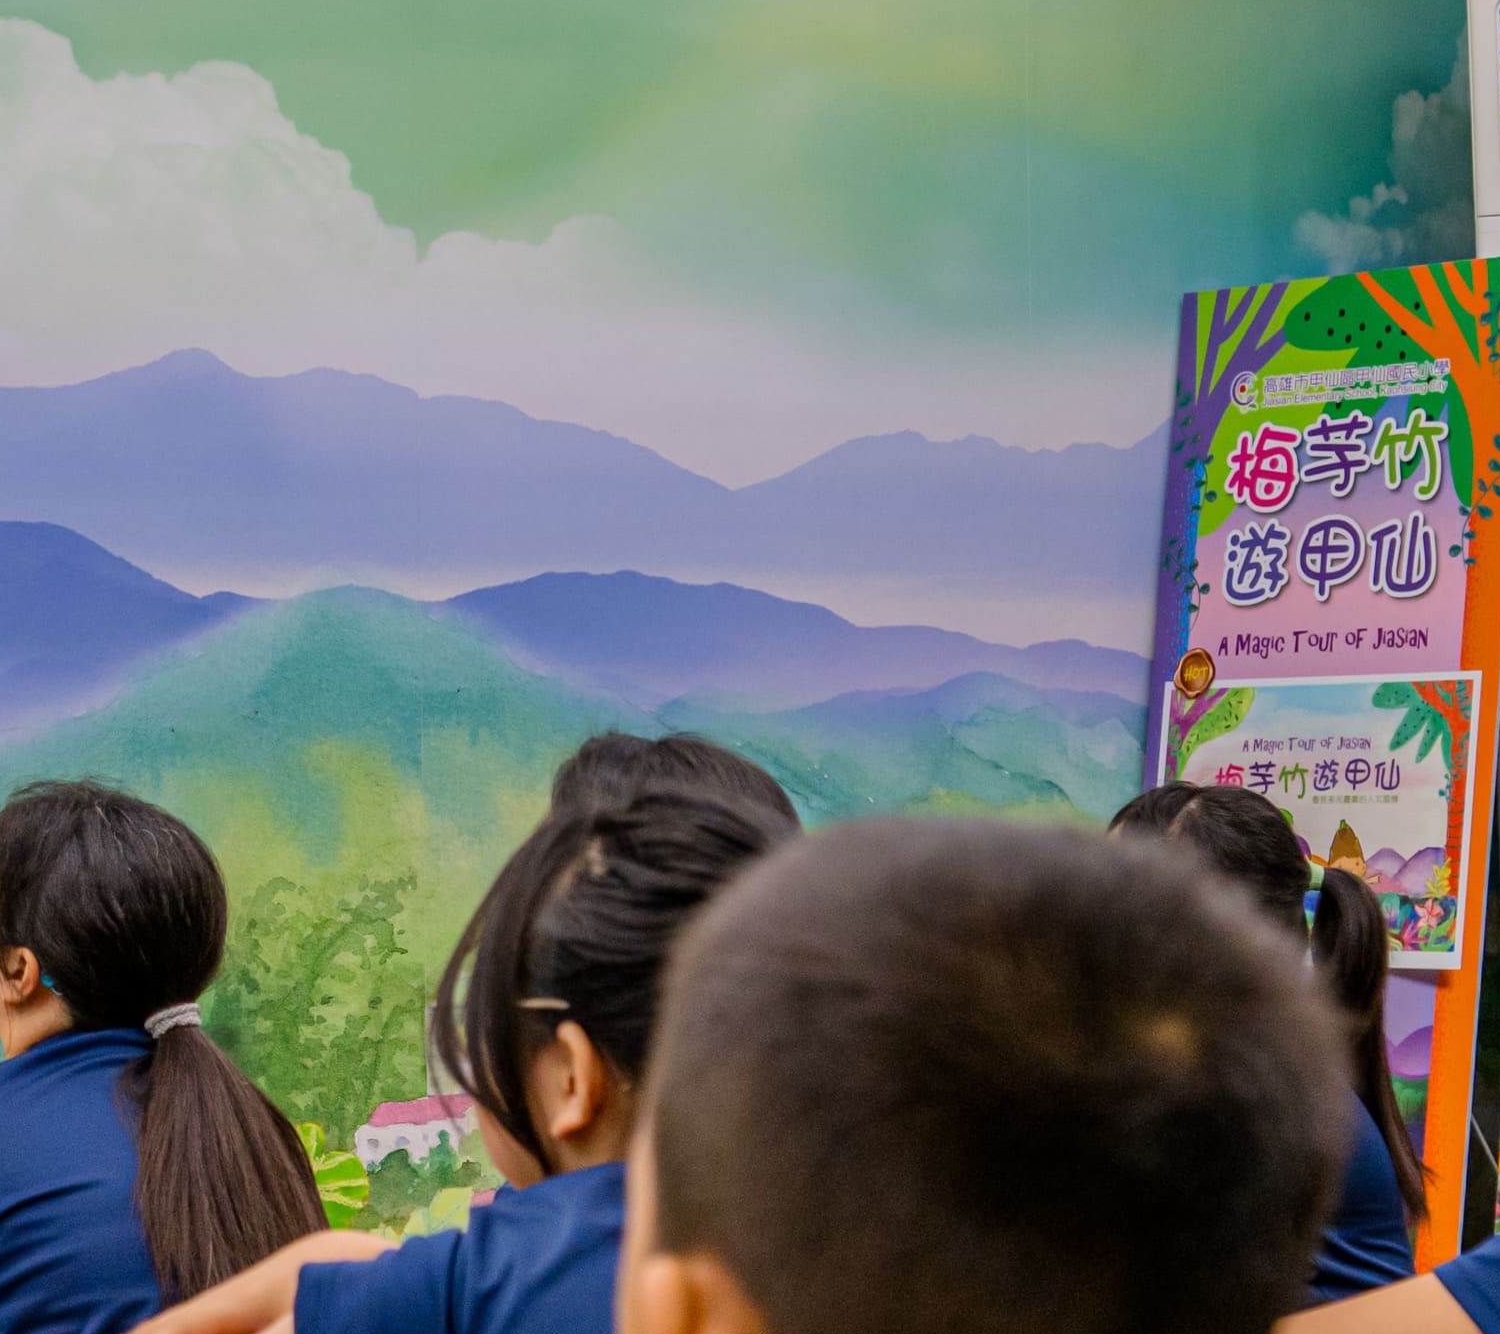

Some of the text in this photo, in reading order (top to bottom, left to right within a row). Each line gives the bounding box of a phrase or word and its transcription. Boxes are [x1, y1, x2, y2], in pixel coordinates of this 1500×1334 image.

[1263, 358, 1450, 395] 高雄市甲仙區甲仙國民小學
[1226, 408, 1449, 513] 梅芋竹
[1222, 510, 1438, 607] 遊甲仙
[1217, 635, 1229, 657] A
